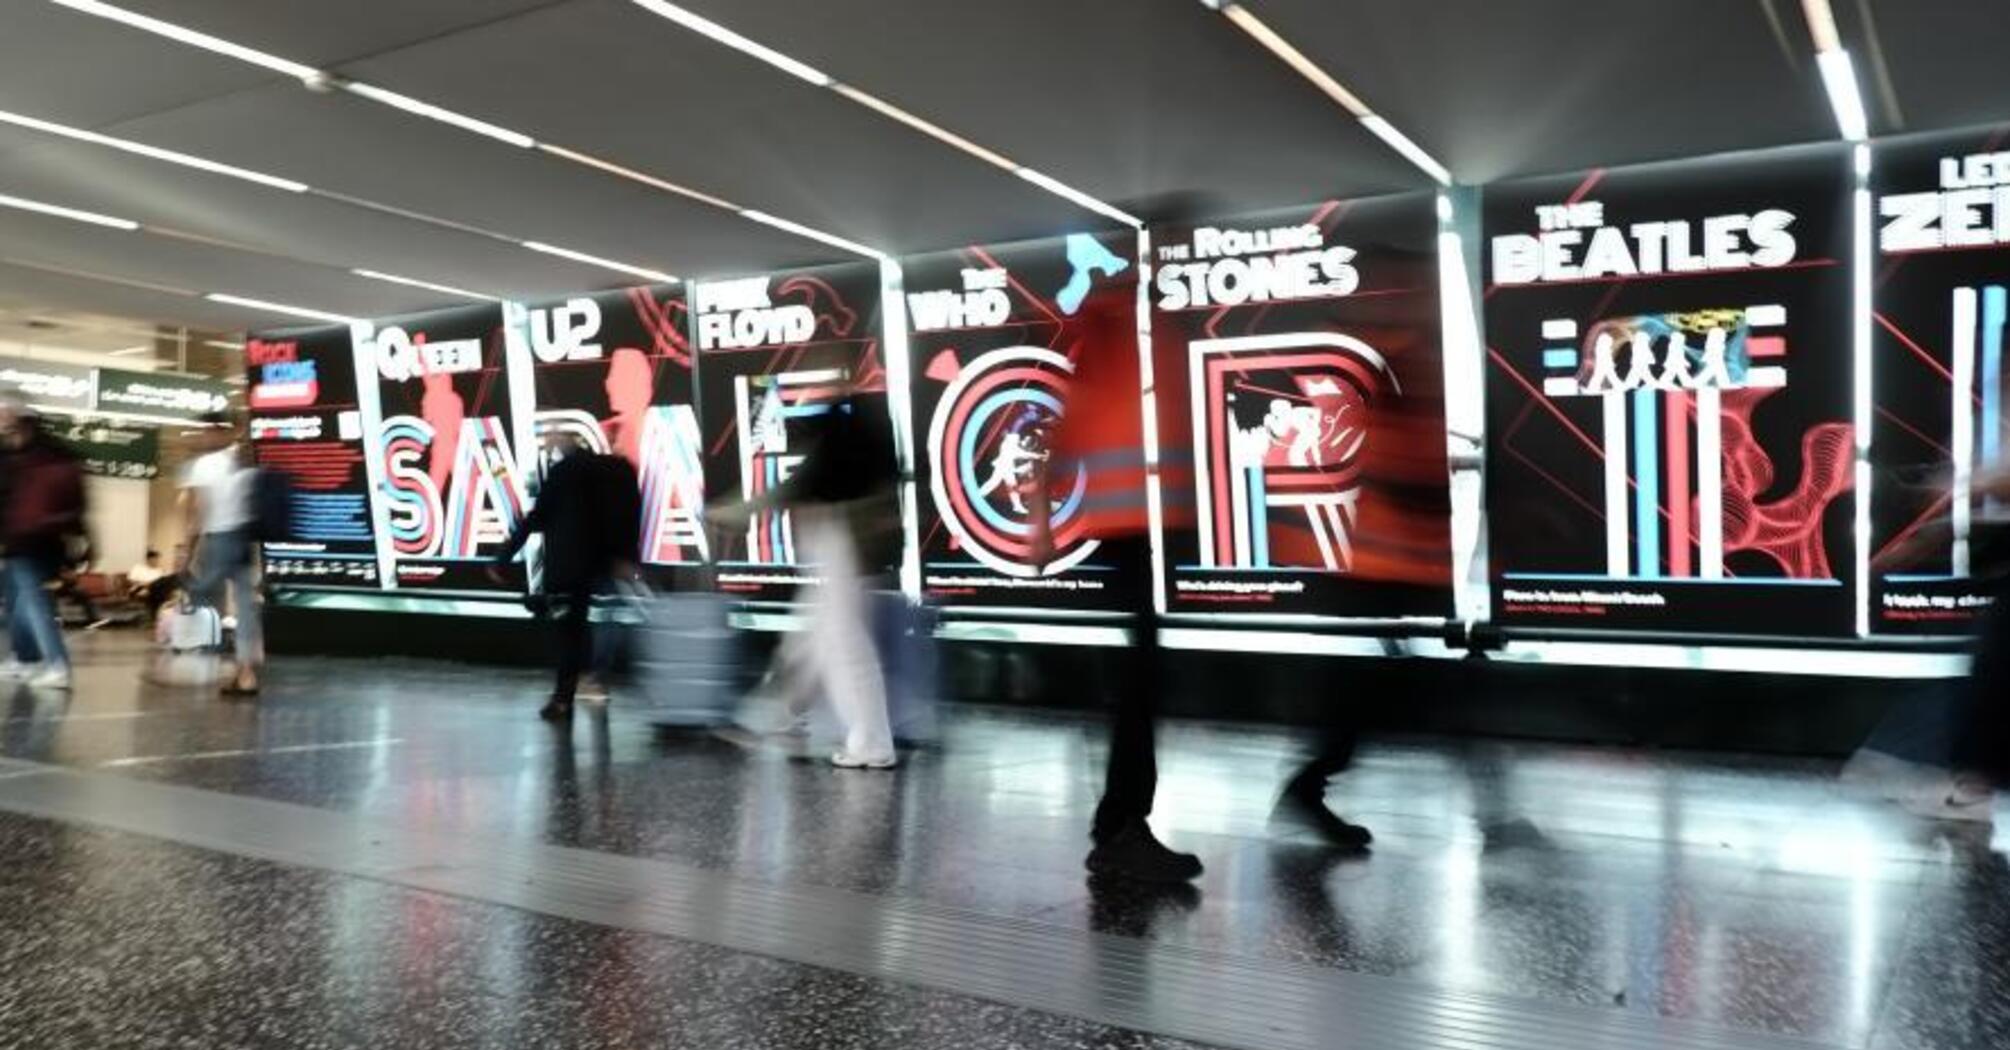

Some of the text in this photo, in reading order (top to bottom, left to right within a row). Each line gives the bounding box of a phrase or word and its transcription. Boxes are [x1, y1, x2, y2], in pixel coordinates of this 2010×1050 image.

[1536, 202, 1604, 230] THE
[1158, 223, 1323, 261] THE ROLLING
[1492, 209, 1797, 285] BEATLES
[961, 268, 1008, 290] THE
[1156, 246, 1359, 311] STONES
[531, 298, 602, 362] U2
[698, 305, 815, 349] FLOYD
[907, 288, 1010, 331] WHO
